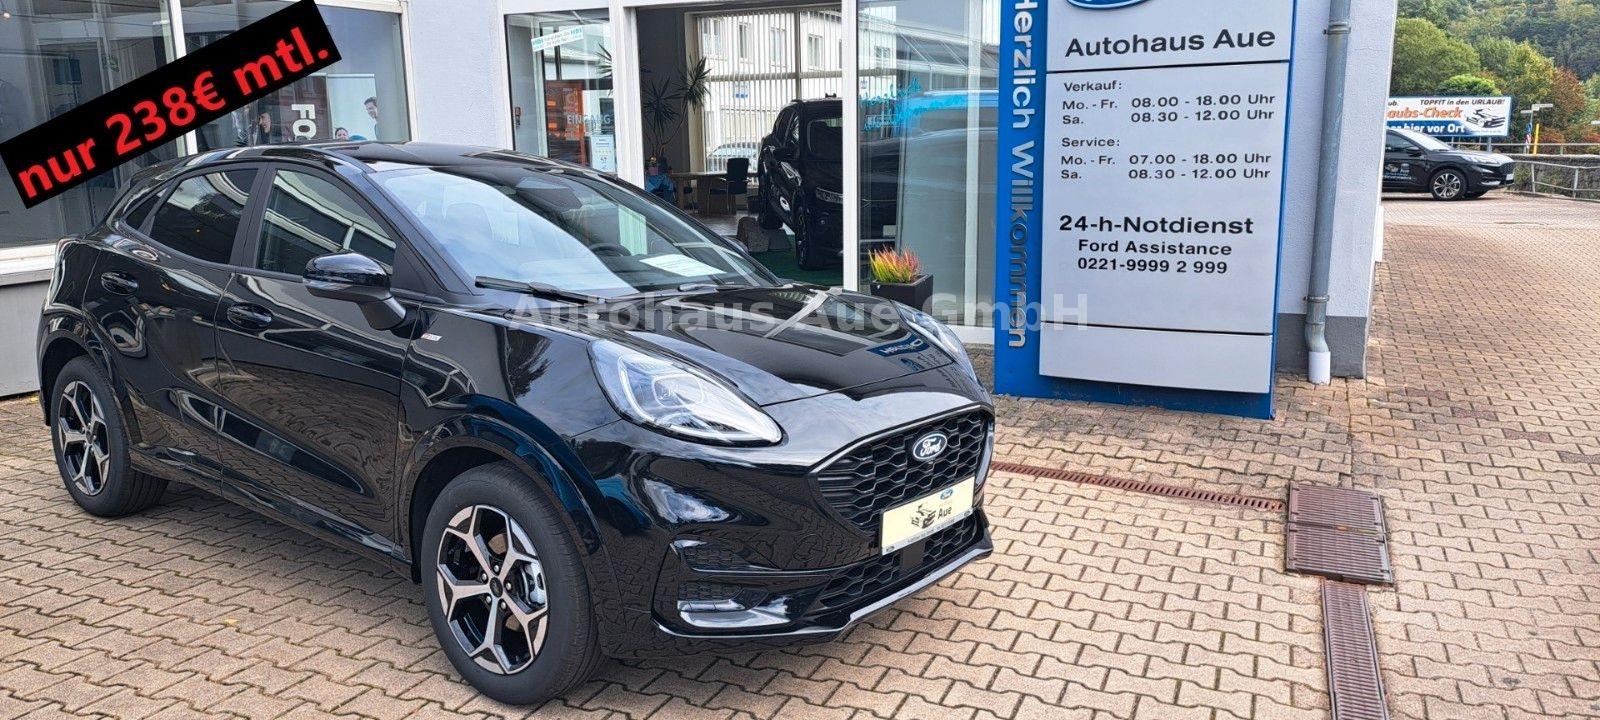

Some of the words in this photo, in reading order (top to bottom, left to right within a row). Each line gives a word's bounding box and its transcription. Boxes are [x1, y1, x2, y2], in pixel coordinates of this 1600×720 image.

[1064, 34, 1205, 57] Autohaus
[1212, 29, 1276, 49] Aue
[1064, 80, 1122, 92] Verkauf:
[1062, 100, 1089, 110] Mo.
[1101, 99, 1118, 109] Fr.
[1131, 97, 1179, 108] 08.00
[1196, 94, 1242, 106] 18.00
[1248, 94, 1276, 105] Uhr
[1062, 115, 1084, 125] Sa.
[1131, 112, 1178, 122] 08.30
[1195, 110, 1241, 121] 12.00
[1247, 109, 1275, 120] Uhr
[1427, 125, 1445, 133] vor
[1447, 124, 1465, 133] Ort
[1061, 137, 1120, 148] Service:
[1061, 155, 1087, 165] Mo.
[1099, 155, 1116, 165] Fr.
[1129, 155, 1176, 165] 07.00
[1193, 154, 1238, 164] 18.00
[1244, 153, 1272, 163] Uhr
[1061, 170, 1082, 179] Sa.
[1128, 169, 1175, 179] 08.30
[1192, 169, 1237, 179] 12.00
[1243, 168, 1271, 178] Uhr
[1059, 215, 1254, 234] 24-h-Notdienst
[1009, 140, 1035, 347] Willkommen
[1078, 239, 1118, 252] Ford
[1125, 241, 1232, 255] Assistance
[1078, 258, 1169, 272] 0221-9999
[1176, 262, 1187, 273] 2
[1193, 261, 1227, 274] 999
[920, 437, 942, 457] Ford
[938, 506, 952, 519] Aue
